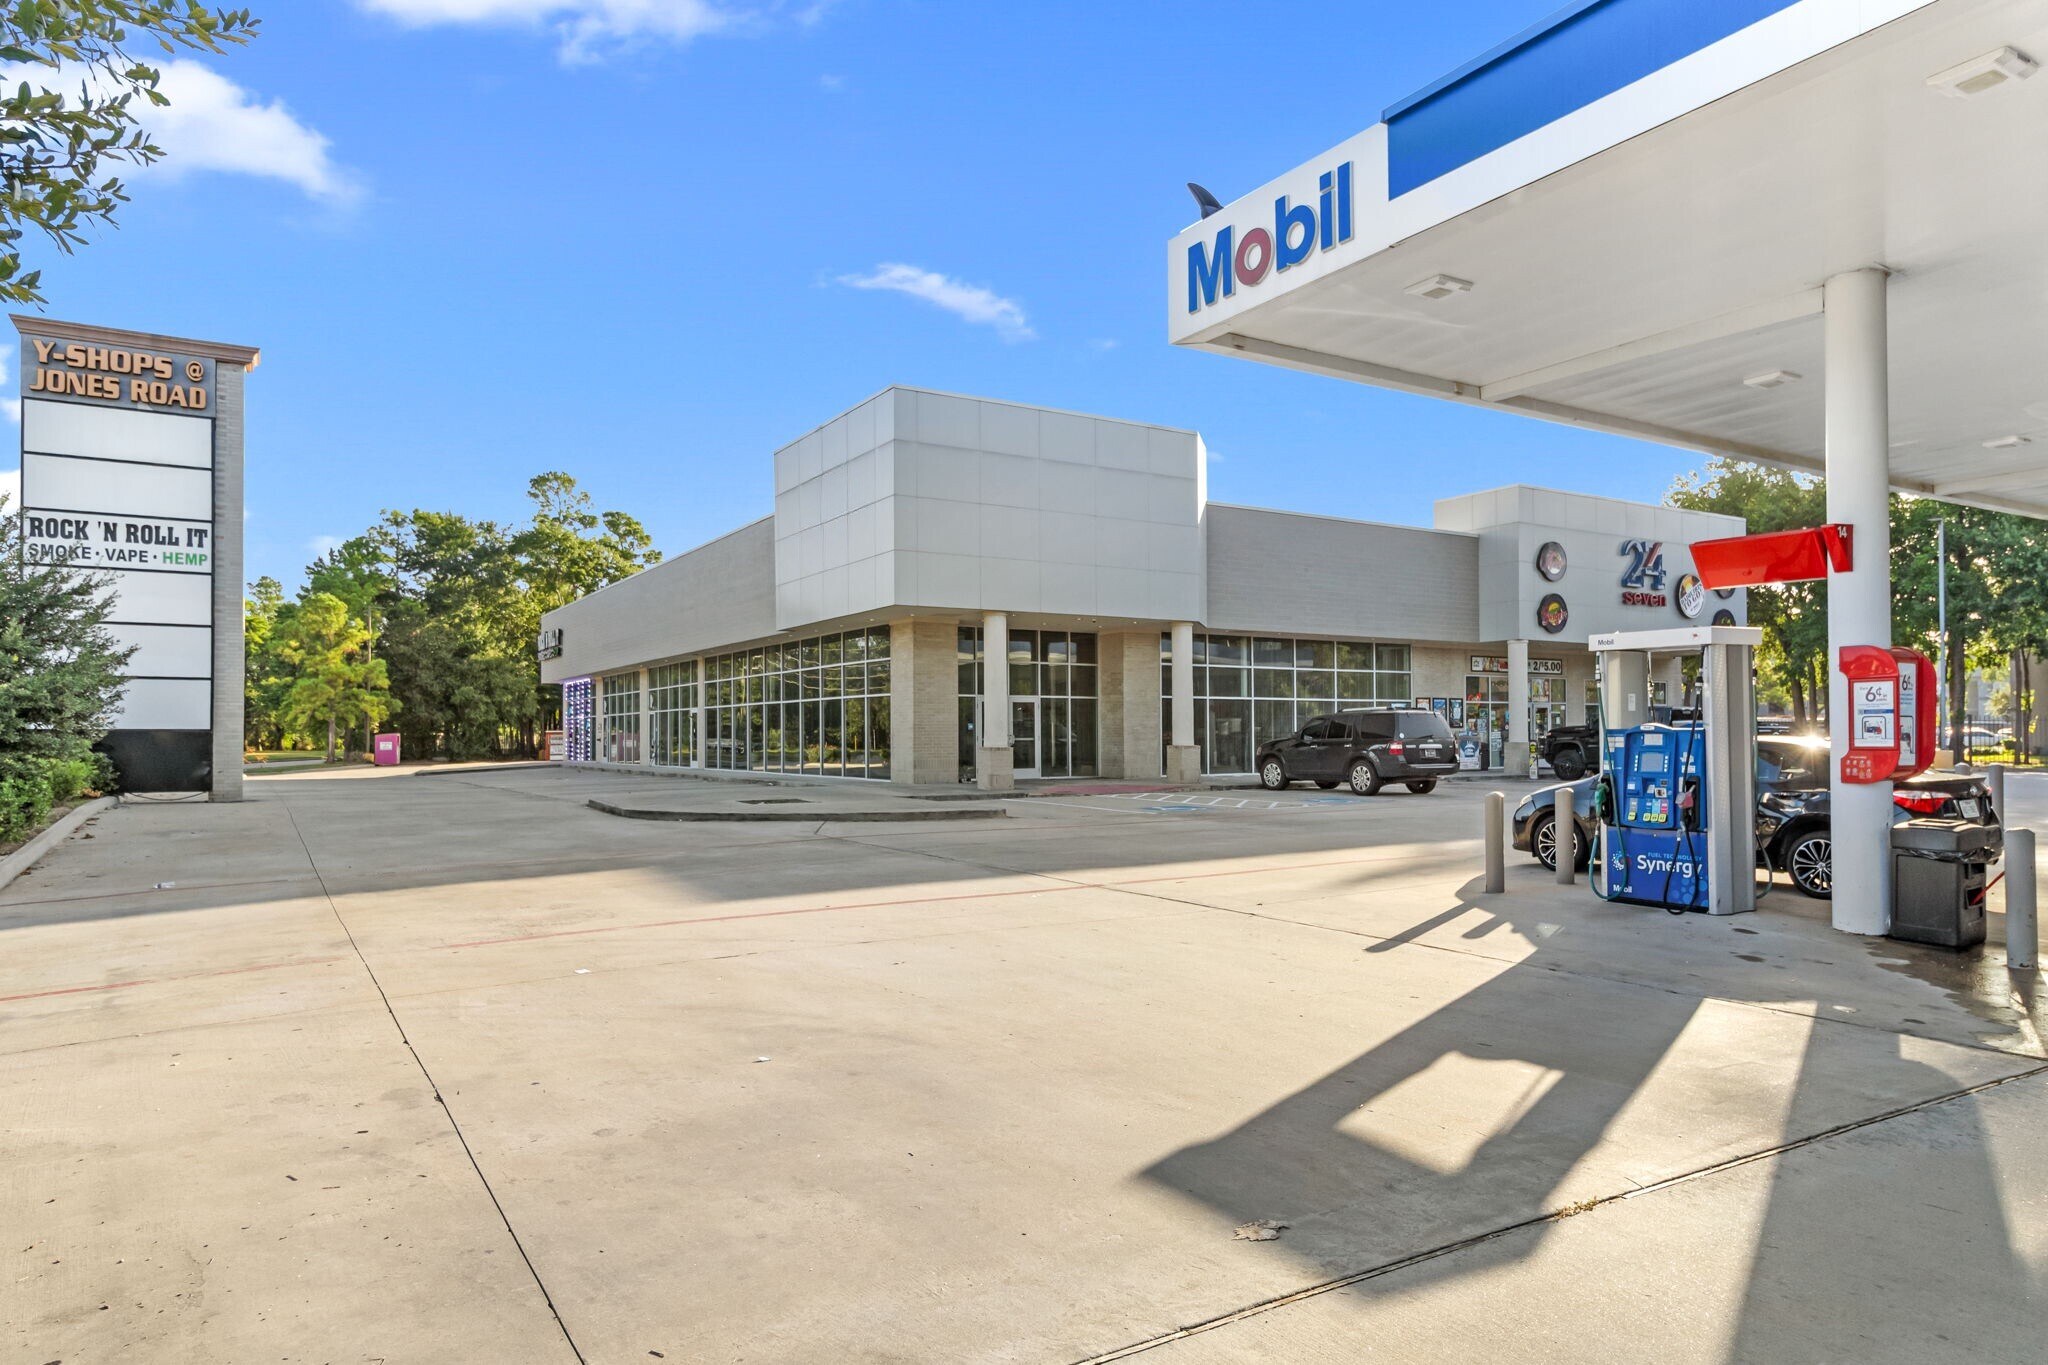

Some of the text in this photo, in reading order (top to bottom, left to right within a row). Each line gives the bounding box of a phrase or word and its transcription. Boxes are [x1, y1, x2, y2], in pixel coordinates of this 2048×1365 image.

[1187, 160, 1354, 315] Mobil
[32, 339, 205, 382] Y-SHOPS @
[29, 367, 207, 410] JONES ROAD
[29, 517, 208, 548] ROCK 'N ROLL IT
[1837, 525, 1848, 539] 14
[28, 542, 208, 566] SMOKE VAPE HEMP
[1620, 538, 1667, 590] 24
[1622, 591, 1667, 607] seven
[1597, 638, 1615, 646] Mobil
[1865, 686, 1882, 702] 6¢
